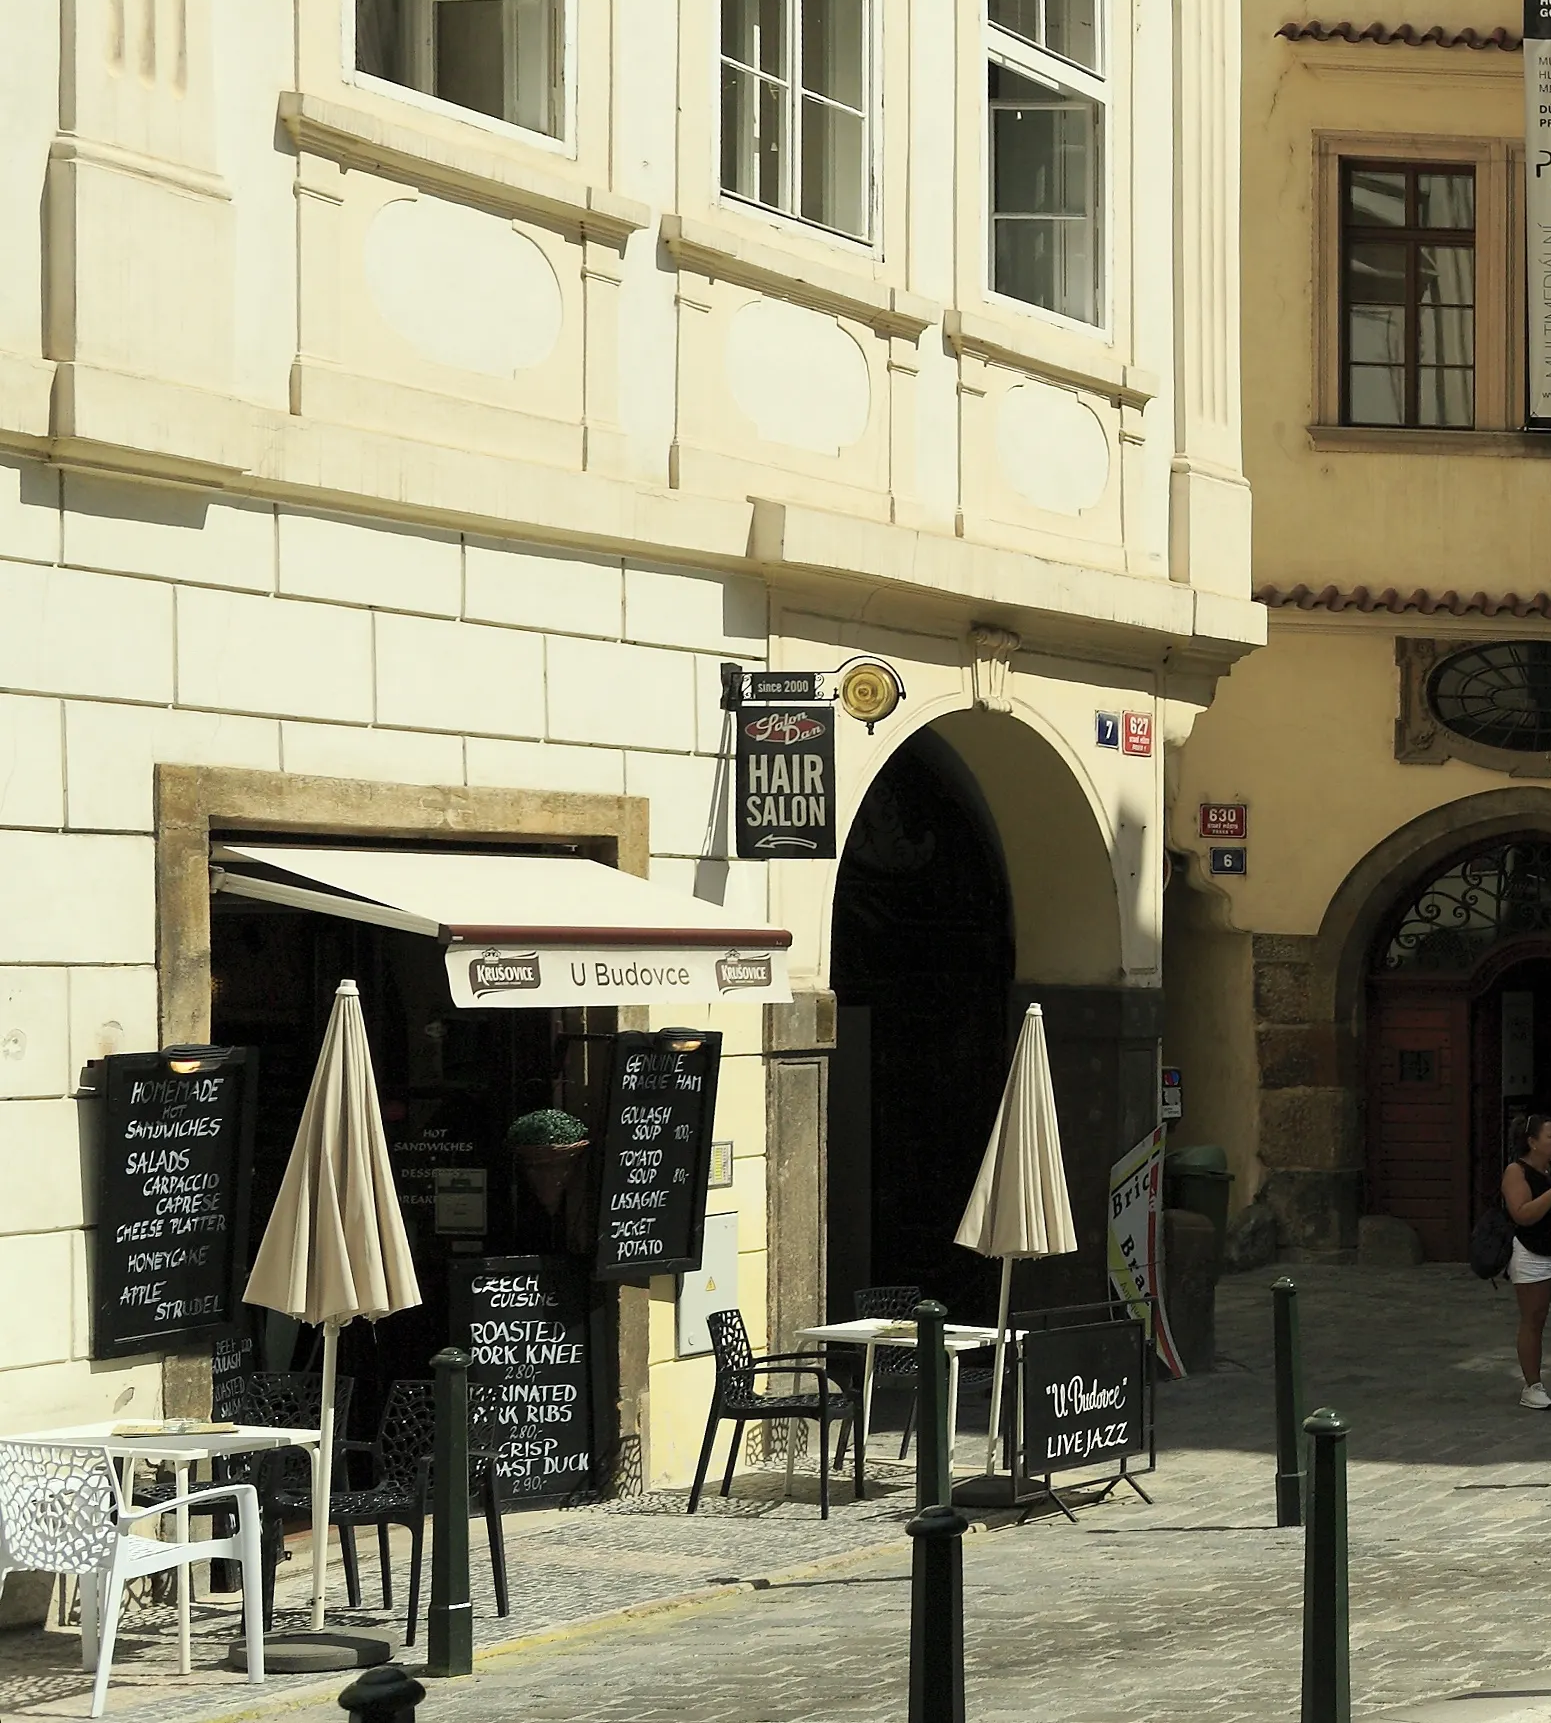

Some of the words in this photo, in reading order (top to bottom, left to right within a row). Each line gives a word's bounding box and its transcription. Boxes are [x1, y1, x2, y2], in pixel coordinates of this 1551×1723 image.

[757, 681, 782, 693] since
[784, 680, 809, 693] 2000
[755, 712, 809, 742] Salon
[784, 724, 821, 746] Dan
[1105, 721, 1113, 740] 7
[1130, 716, 1149, 735] 627
[749, 753, 825, 794] HAIR
[746, 796, 826, 827] SALON
[1209, 808, 1236, 823] 630
[1223, 854, 1233, 868] 6
[477, 963, 535, 986] KRUŠOVICE
[570, 962, 587, 986] U
[595, 962, 690, 986] Budovce
[626, 1054, 687, 1074] GENUINE
[129, 1078, 224, 1105] HOMEMADE
[622, 1073, 669, 1091] PRAGUE
[675, 1075, 702, 1092] HAM
[162, 1103, 188, 1120] HOT
[621, 1106, 672, 1125] GOULASH
[124, 1118, 223, 1140] SANDWICHES
[423, 1128, 449, 1139] HOT
[632, 1124, 662, 1141] SOUP
[394, 1141, 474, 1153] SANDWICHES
[619, 1149, 663, 1167] TOMATO
[125, 1148, 190, 1175] SALADS
[143, 1173, 220, 1197] CARPACCIO
[627, 1168, 658, 1185] SOUP
[156, 1193, 221, 1216] CAPRESE
[611, 1190, 669, 1211] LASAGNE
[1111, 1172, 1150, 1220] Bric
[116, 1220, 163, 1244] CHEESE
[169, 1215, 227, 1234] PLATTER
[611, 1217, 657, 1239] JACKET
[128, 1245, 209, 1273] HONEYCAKE
[617, 1239, 663, 1261] POTATO
[119, 1281, 168, 1306] APPLE
[471, 1274, 540, 1294] CZECH
[154, 1295, 224, 1322] STRUDEL
[490, 1291, 559, 1308] CUISINE
[470, 1320, 566, 1344] ROASTED
[470, 1344, 518, 1365] PORK
[526, 1344, 584, 1365] KNEE
[215, 1375, 246, 1402] OASTED
[527, 1405, 573, 1424] RIBS
[497, 1438, 559, 1458] CRISP
[1047, 1430, 1083, 1459] LIVE
[1083, 1421, 1129, 1458] JAZZ
[543, 1453, 590, 1475] DUCK
